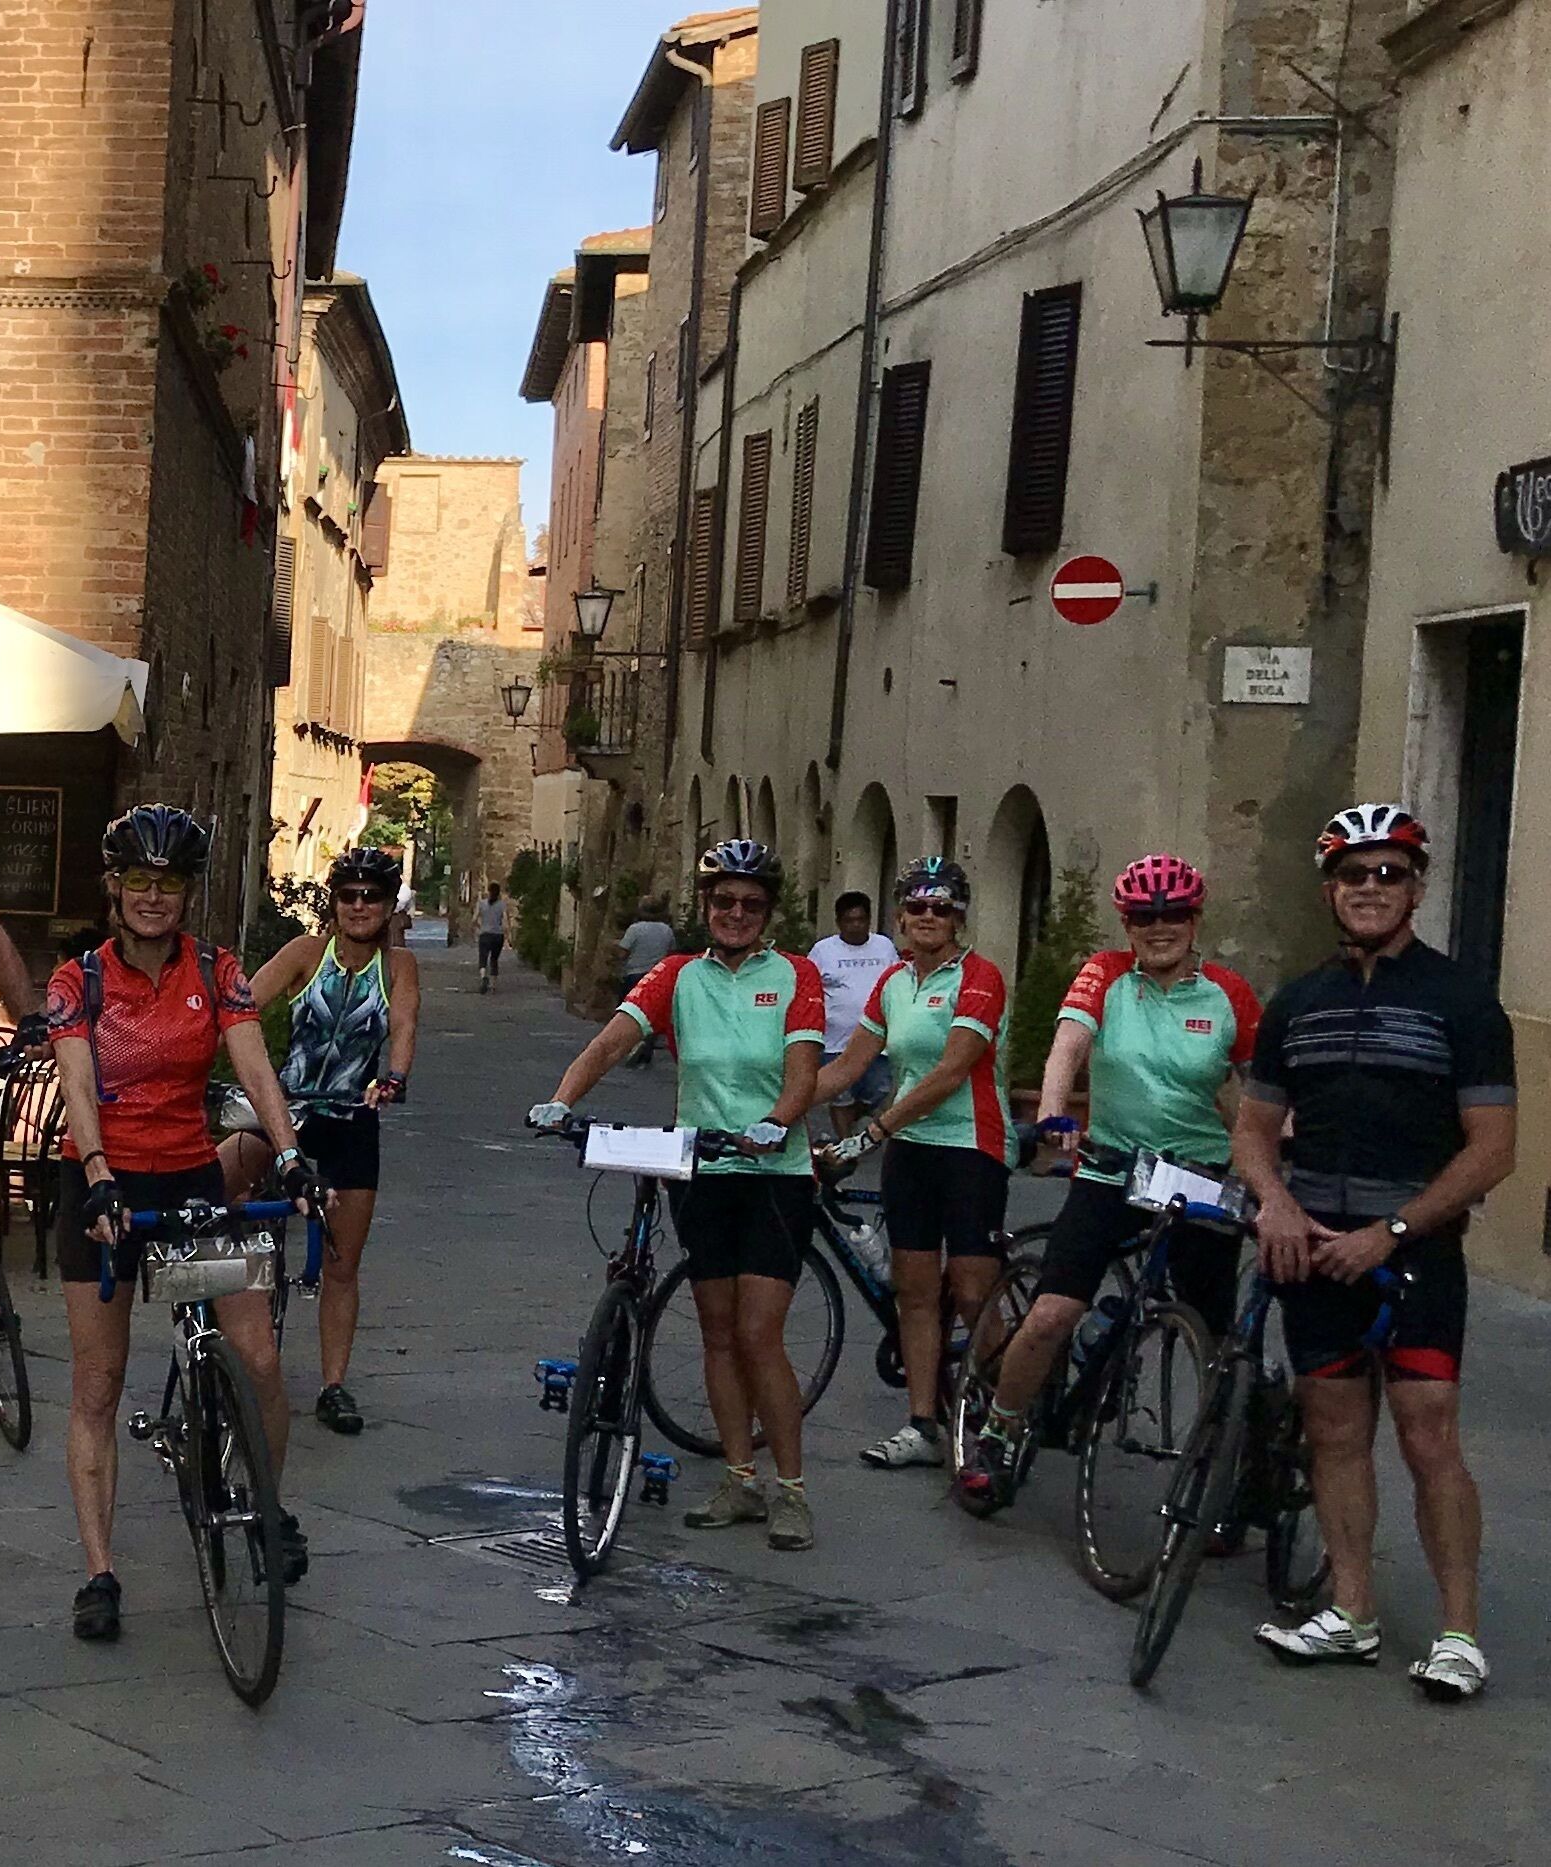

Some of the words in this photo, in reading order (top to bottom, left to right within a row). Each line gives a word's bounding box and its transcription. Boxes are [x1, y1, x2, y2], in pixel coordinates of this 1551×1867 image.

[1258, 652, 1280, 665] VIA
[1245, 669, 1290, 680] DELLA
[755, 992, 779, 1004] REI
[1185, 1019, 1212, 1031] REI
